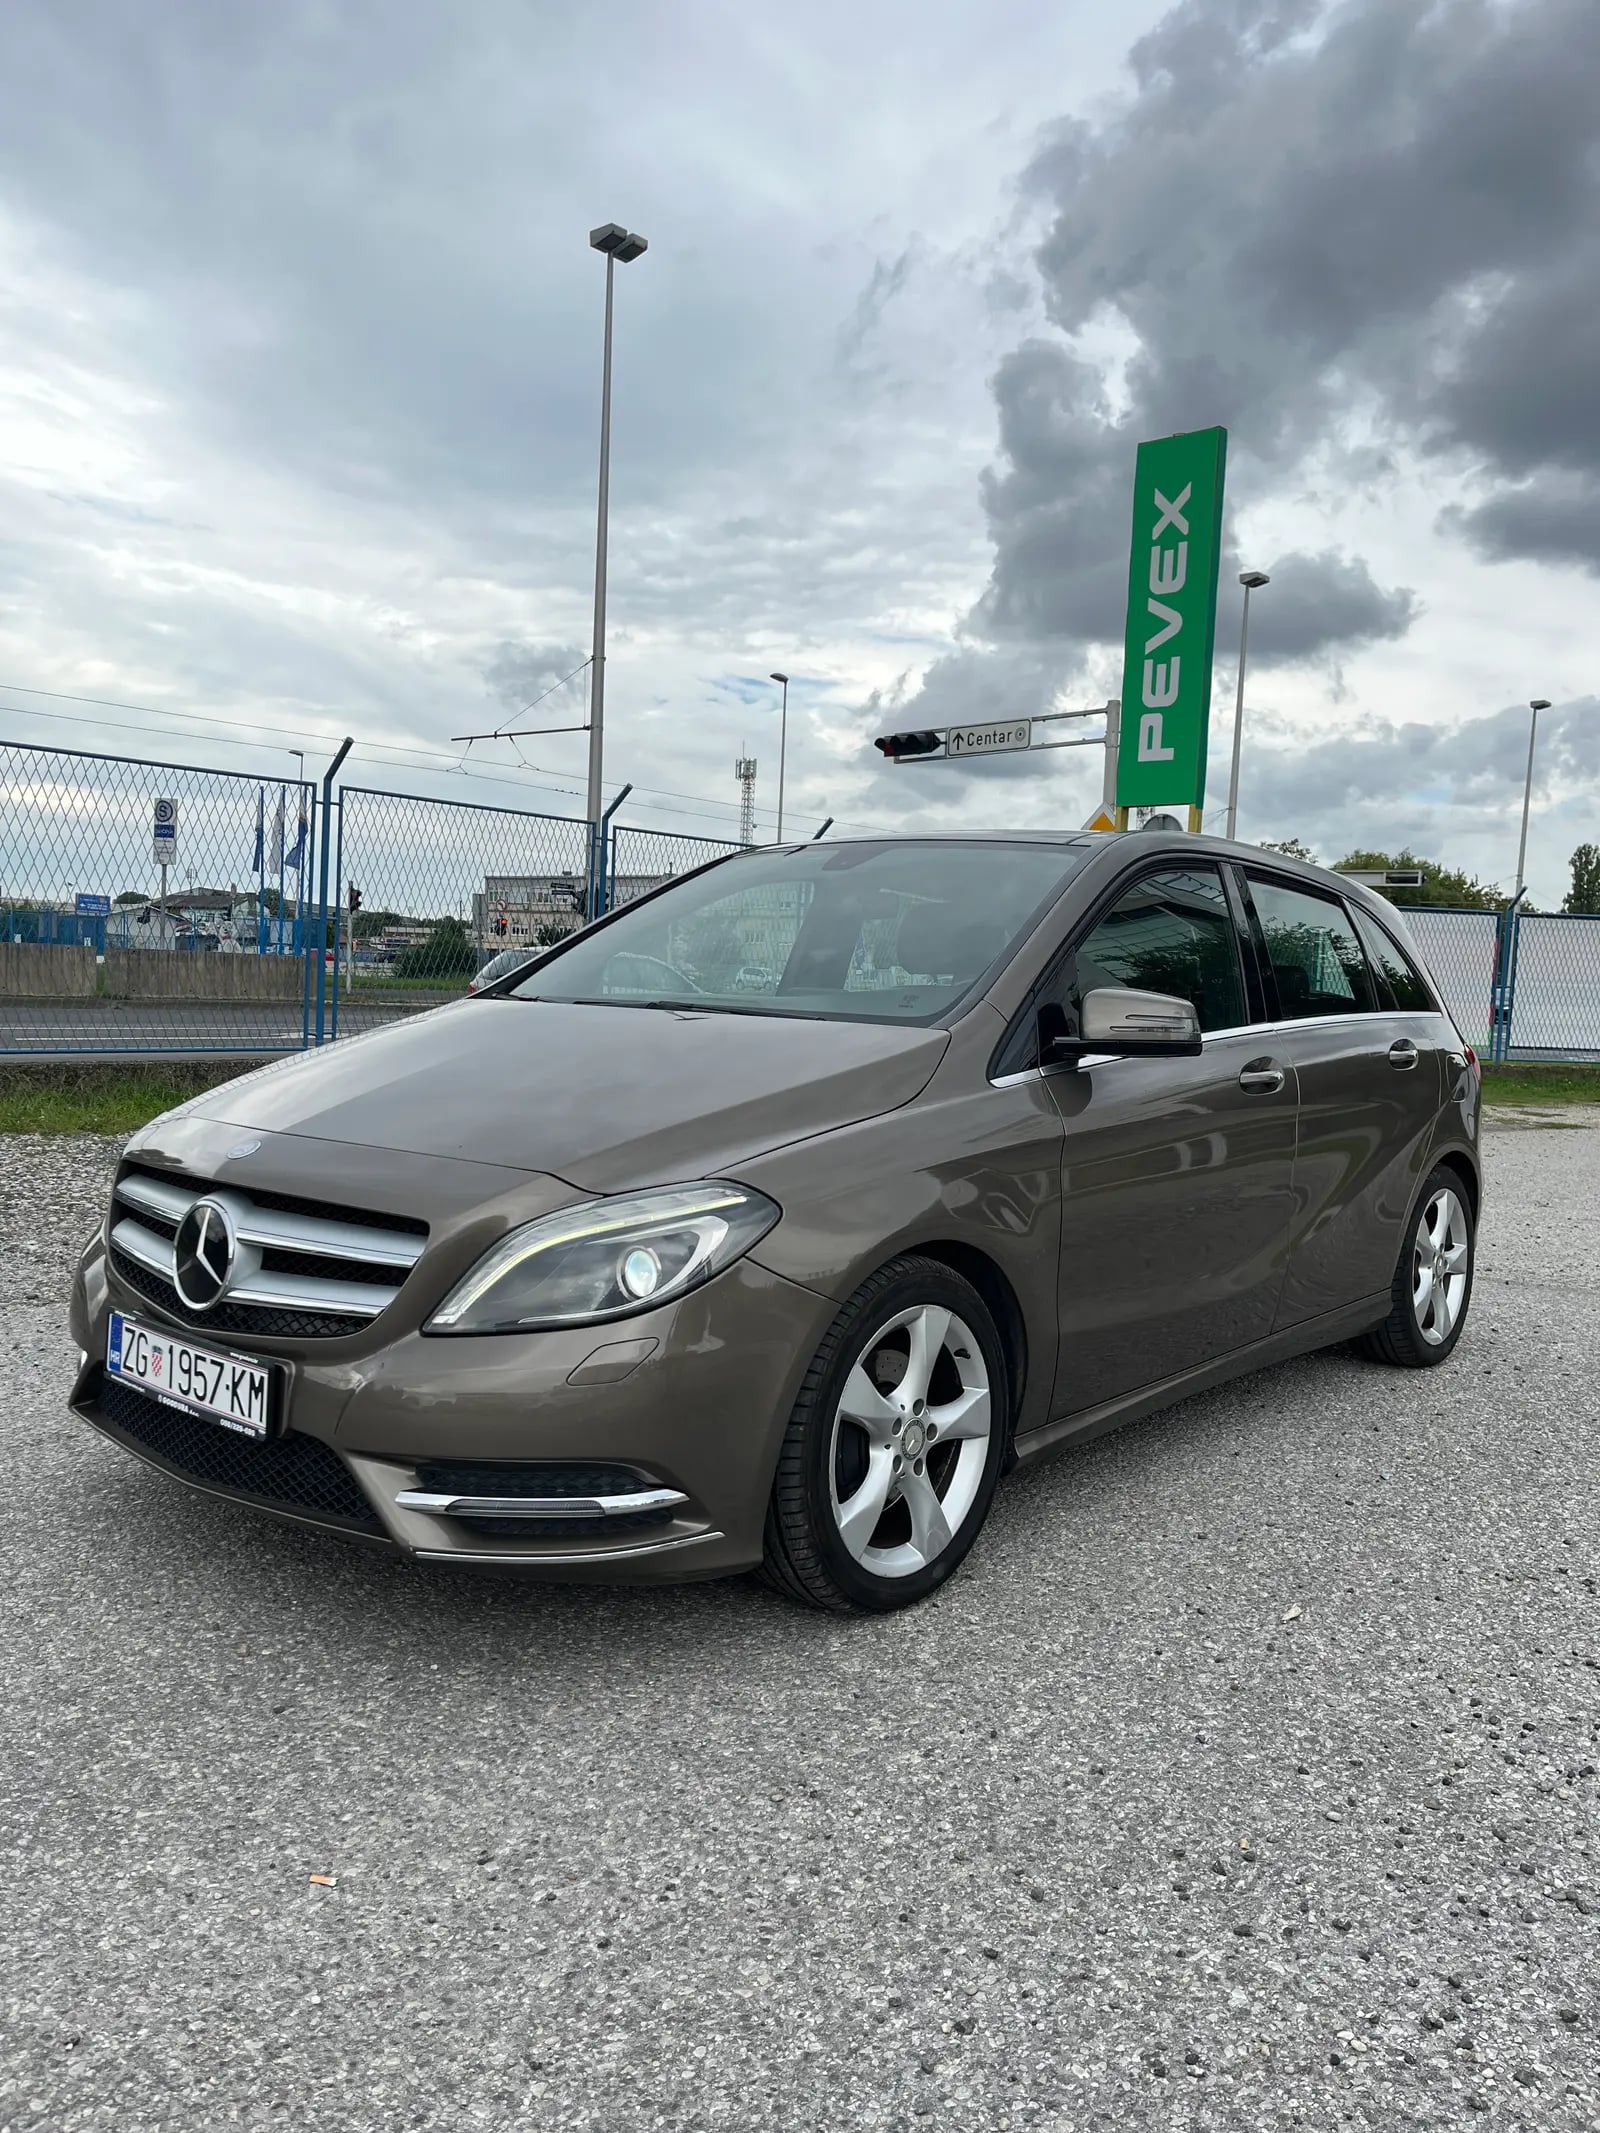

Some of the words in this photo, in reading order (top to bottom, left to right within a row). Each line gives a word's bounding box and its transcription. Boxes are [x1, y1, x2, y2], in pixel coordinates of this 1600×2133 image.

[1138, 481, 1192, 762] PEVEX
[967, 730, 1013, 746] Centar
[159, 805, 168, 818] S
[110, 1349, 121, 1365] HR
[123, 1326, 149, 1377] ZG
